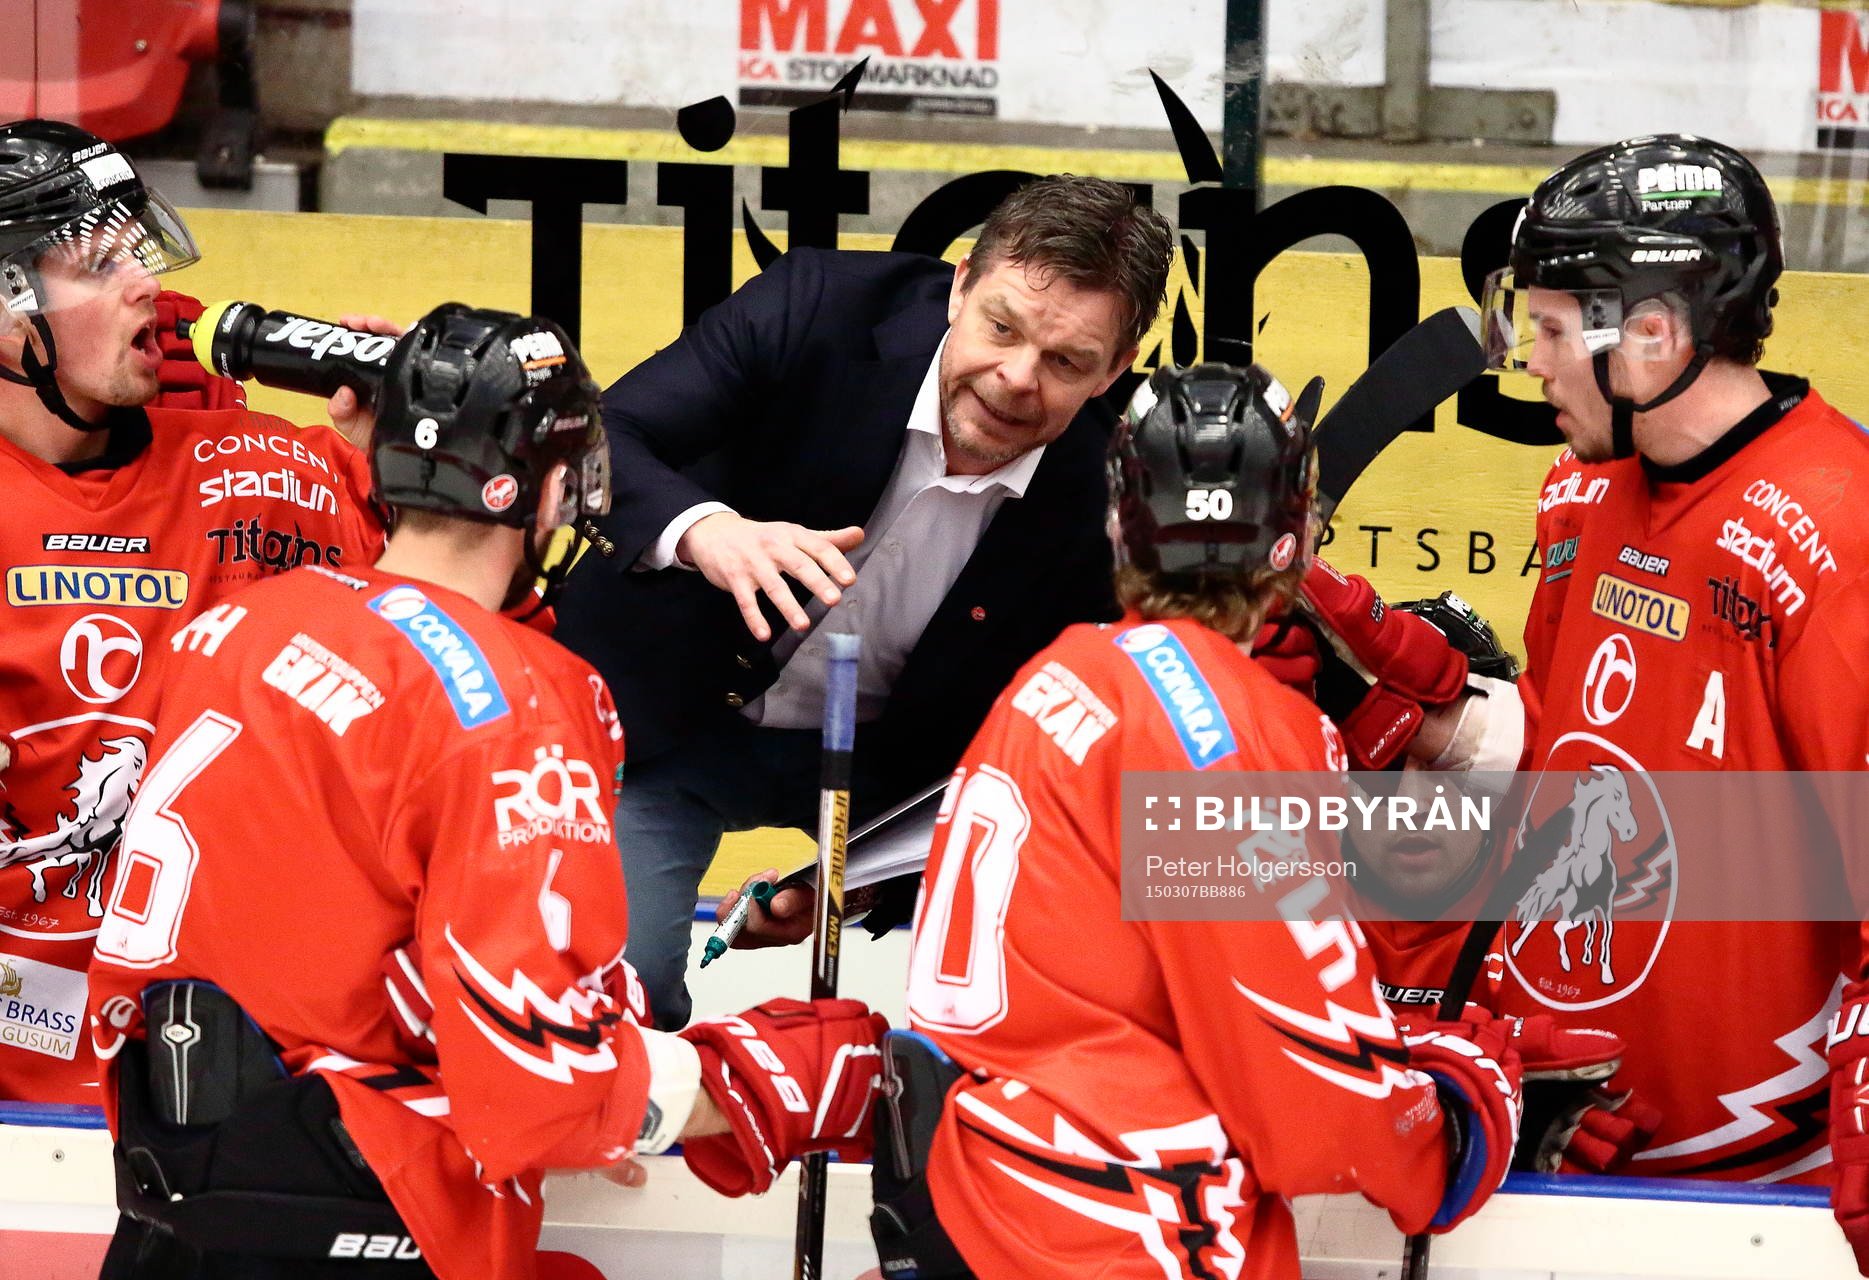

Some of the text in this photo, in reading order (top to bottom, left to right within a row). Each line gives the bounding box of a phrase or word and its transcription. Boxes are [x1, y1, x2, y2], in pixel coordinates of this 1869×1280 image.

[739, 0, 998, 61] MAXI
[738, 57, 780, 81] ICA
[1816, 98, 1859, 122] ICA
[1641, 199, 1692, 213] Partner
[414, 417, 439, 450] 6
[193, 433, 340, 484] CONCEN
[1185, 488, 1234, 521] 50
[45, 534, 148, 553] BAUER
[206, 512, 344, 574] Titans
[1743, 478, 1838, 577] CONCENT
[1617, 545, 1670, 576] BAUER
[1715, 516, 1807, 617] stadium
[14, 571, 183, 605] LINOTOL
[1595, 577, 1681, 637] LINOTOL
[1685, 669, 1726, 760] A
[491, 743, 609, 832] RÖR
[94, 708, 243, 970] 6
[21, 912, 60, 929] 1967
[6, 1000, 76, 1034] BRASS
[2, 1026, 71, 1056] GUSUM
